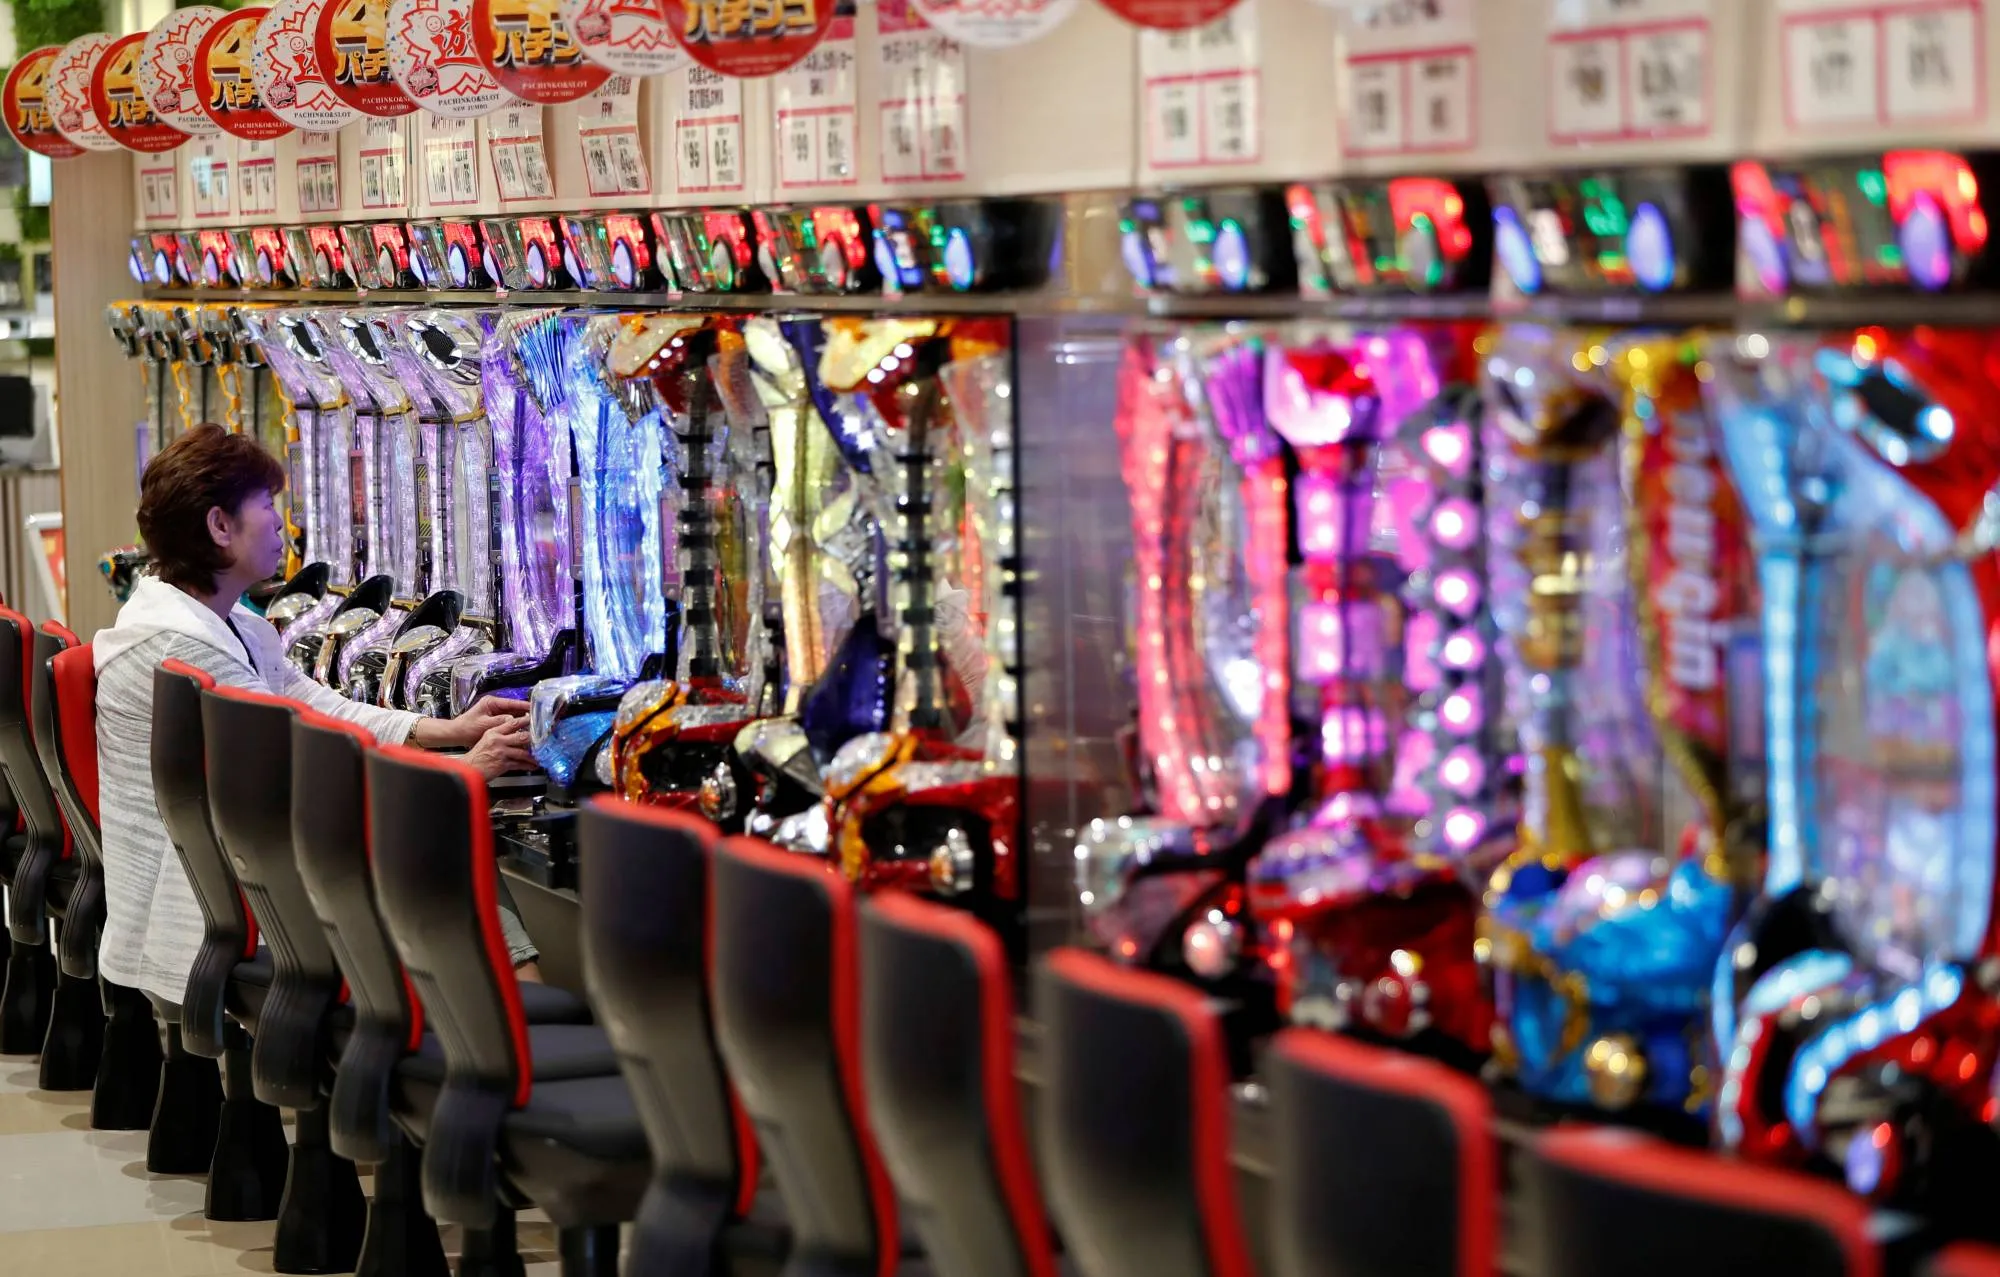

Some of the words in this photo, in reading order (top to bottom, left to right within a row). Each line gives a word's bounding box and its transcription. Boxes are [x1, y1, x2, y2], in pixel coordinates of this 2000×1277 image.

[494, 30, 582, 67] パチン
[335, 51, 393, 84] パチ
[438, 94, 500, 105] PACHINKO&SLOT
